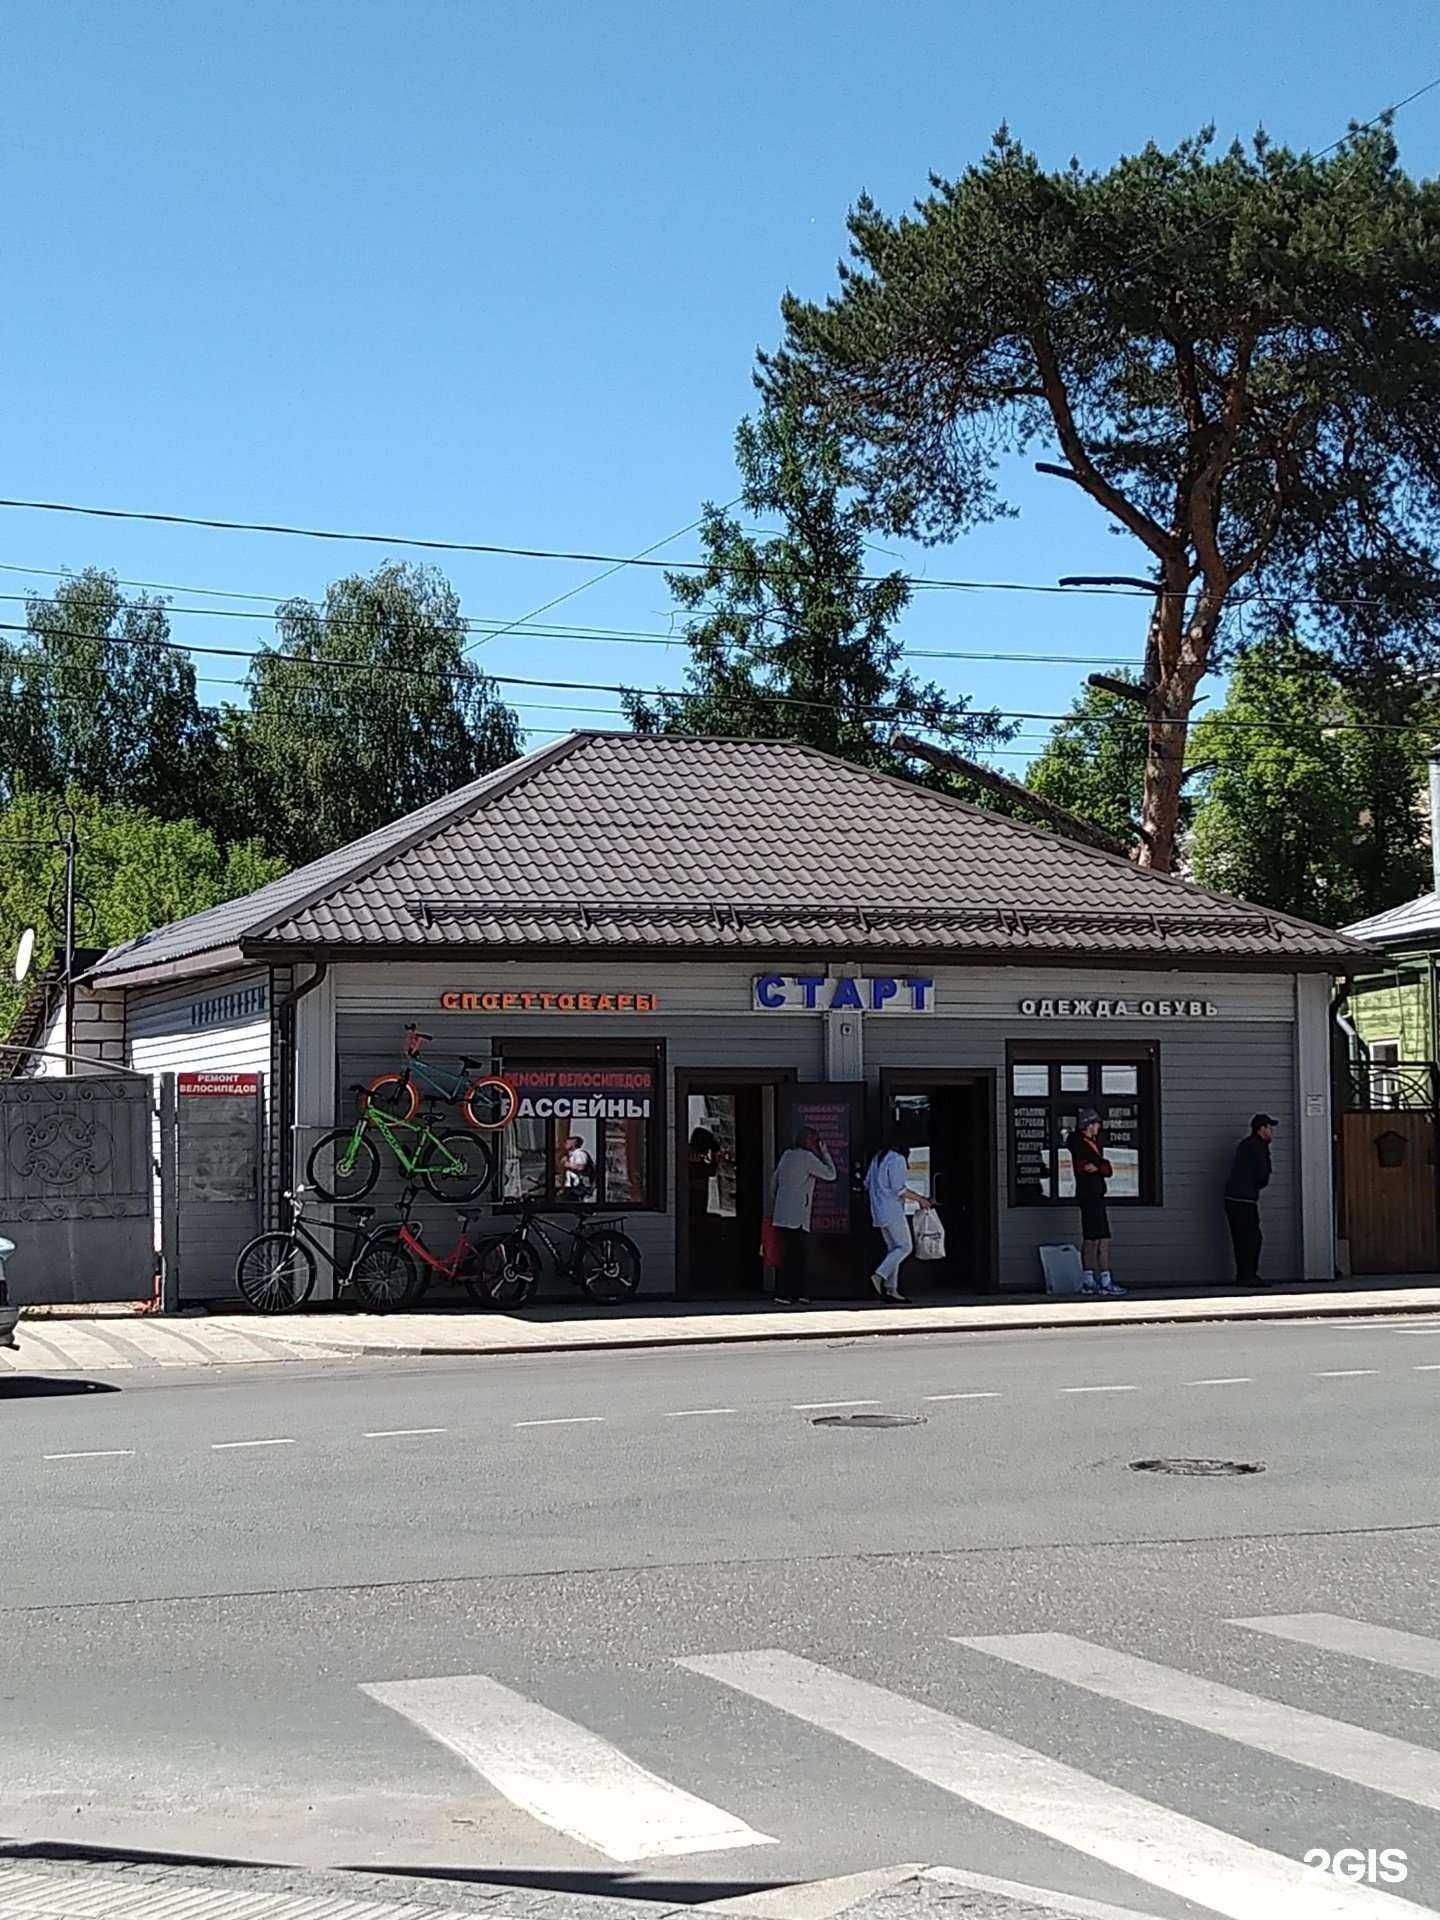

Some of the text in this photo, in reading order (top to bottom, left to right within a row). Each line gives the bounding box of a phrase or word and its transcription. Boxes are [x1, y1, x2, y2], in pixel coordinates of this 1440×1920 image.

[442, 992, 657, 1010] СПОРТТОВАРЫ
[757, 976, 933, 1010] СТАРТ
[1022, 999, 1218, 1017] ОДЕЖДА ОБУВЬ
[197, 1074, 240, 1083] РЕМОНТ
[559, 1073, 652, 1088] ВЕЛОСИПЕДОВ
[179, 1084, 257, 1094] ВЕЛОСИПЕДОВ
